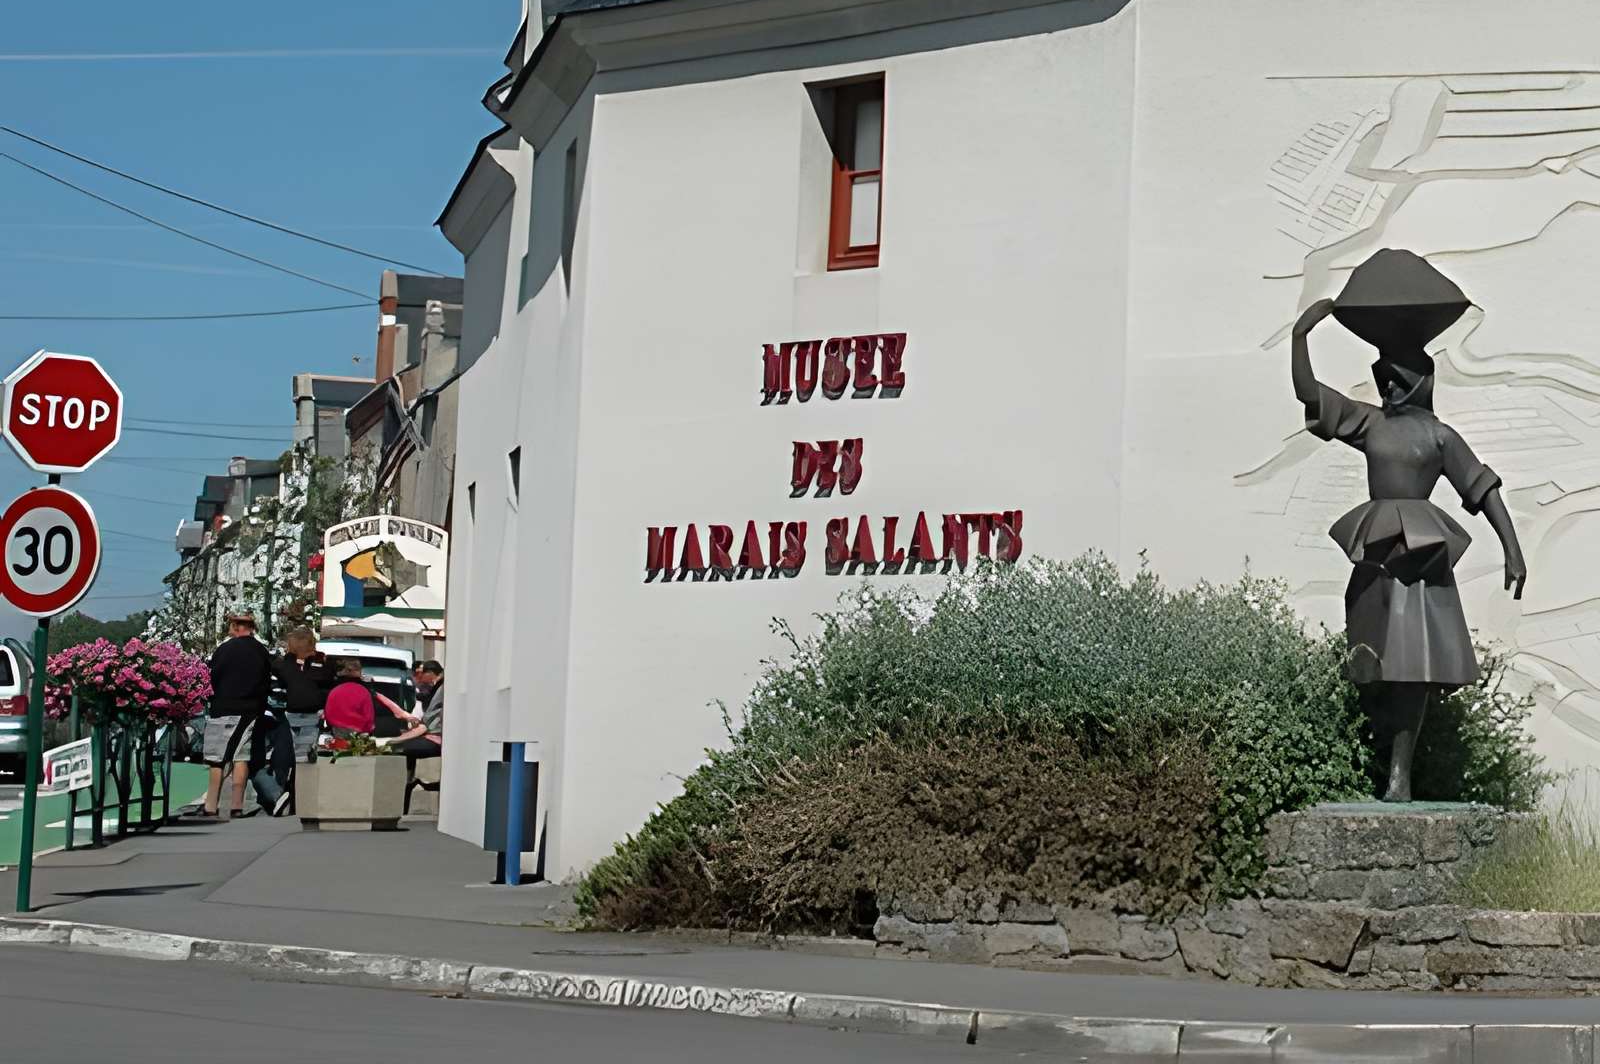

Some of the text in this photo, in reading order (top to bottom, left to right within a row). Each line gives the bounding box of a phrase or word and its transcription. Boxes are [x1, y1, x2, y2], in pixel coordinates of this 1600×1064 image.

[18, 393, 111, 431] STOP
[791, 438, 864, 493] DES
[12, 525, 74, 577] 30
[645, 510, 1023, 578] MARAIS SALANTS
